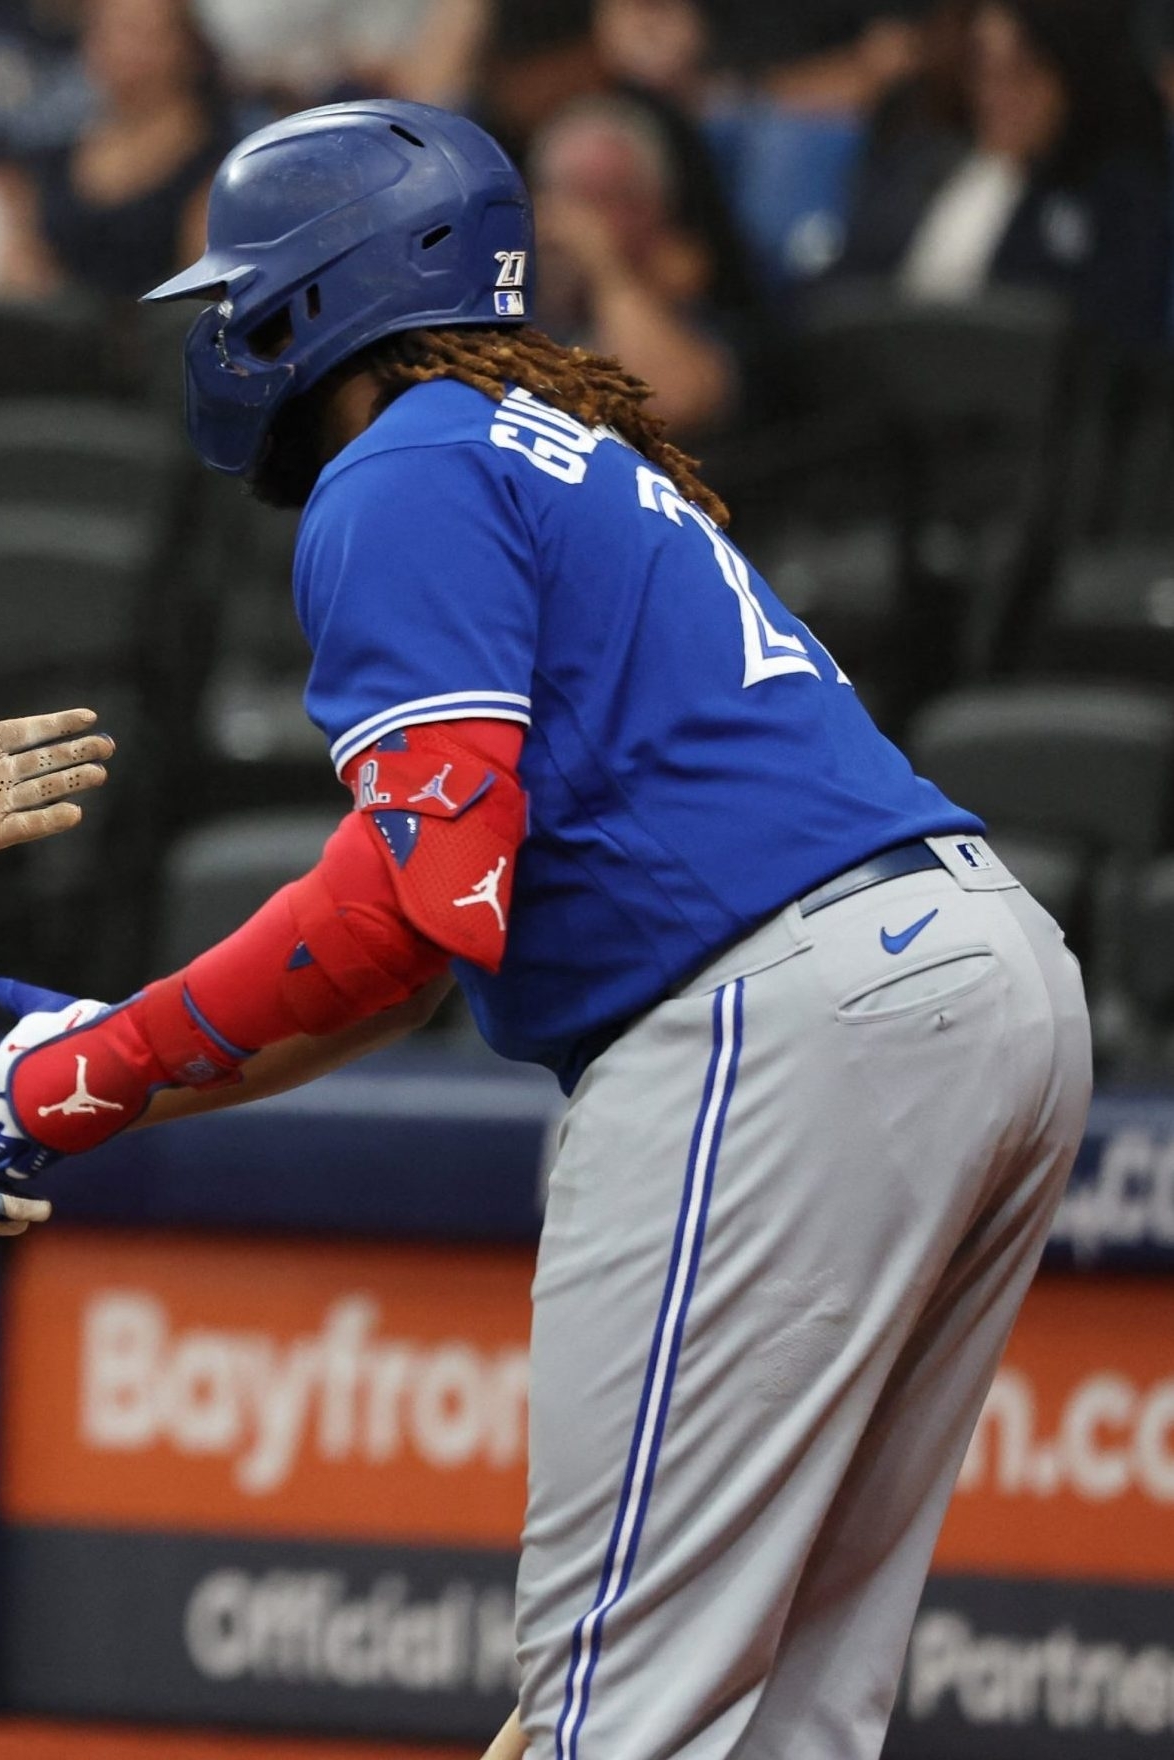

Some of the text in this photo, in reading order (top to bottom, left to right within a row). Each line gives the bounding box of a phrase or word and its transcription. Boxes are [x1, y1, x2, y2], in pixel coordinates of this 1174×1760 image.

[494, 251, 526, 287] 27
[490, 387, 620, 484] GU
[636, 465, 846, 689] 2
[355, 760, 391, 810] R.
[186, 1568, 472, 1690] Official
